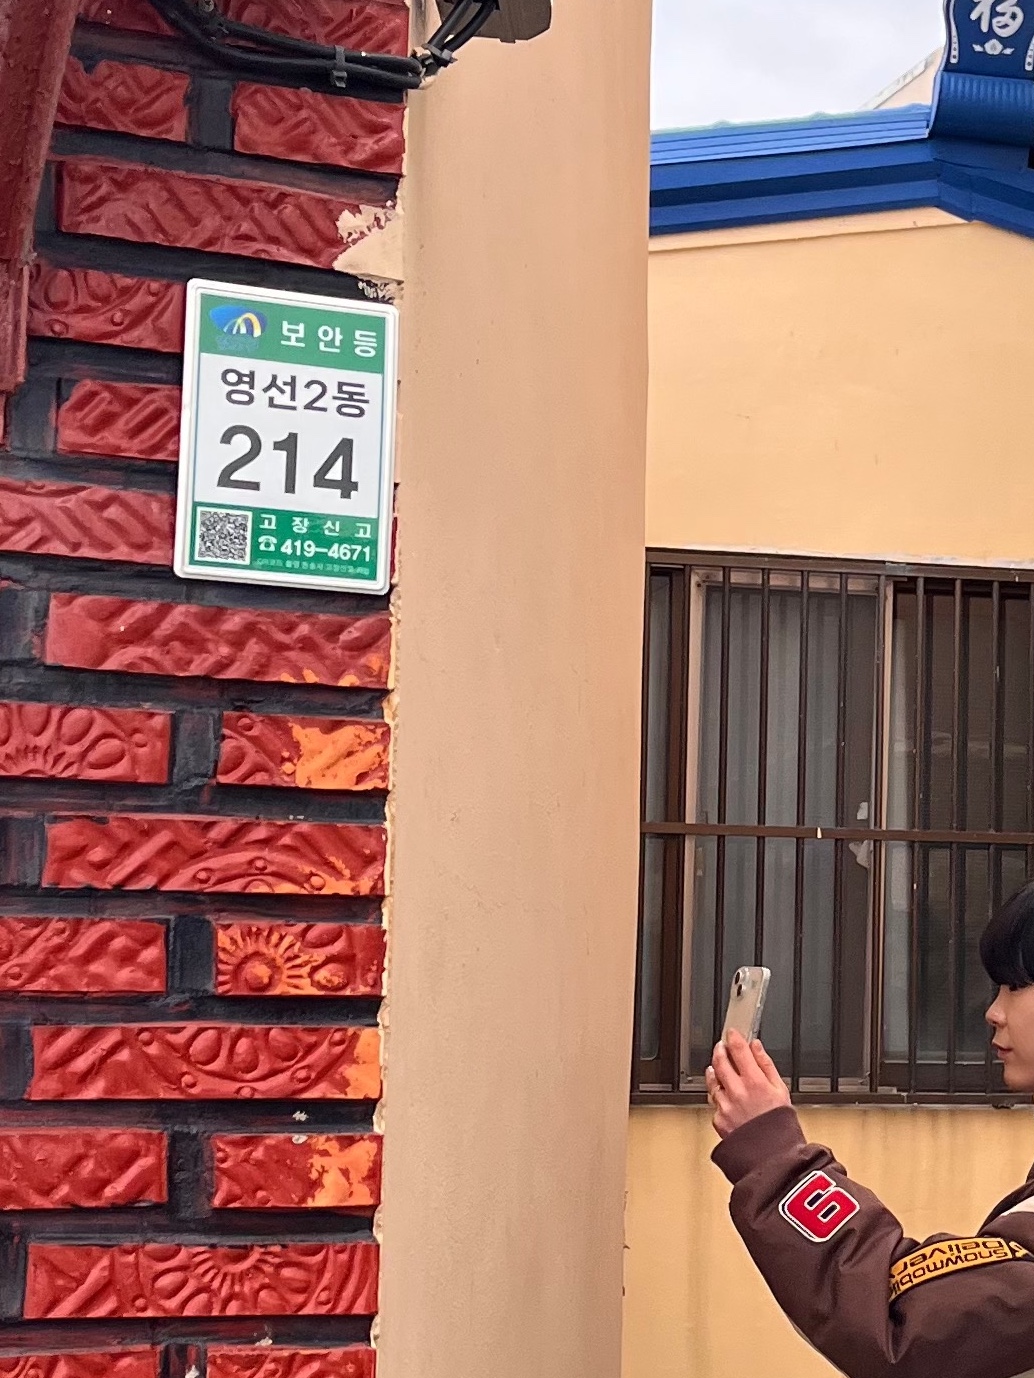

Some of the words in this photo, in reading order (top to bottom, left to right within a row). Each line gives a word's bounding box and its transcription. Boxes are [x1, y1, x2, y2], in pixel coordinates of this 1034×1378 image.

[280, 320, 378, 358] 보안등
[220, 367, 370, 418] 영선2동
[216, 424, 359, 500] 214
[280, 538, 372, 562] 419-4671
[778, 1170, 860, 1243] 6
